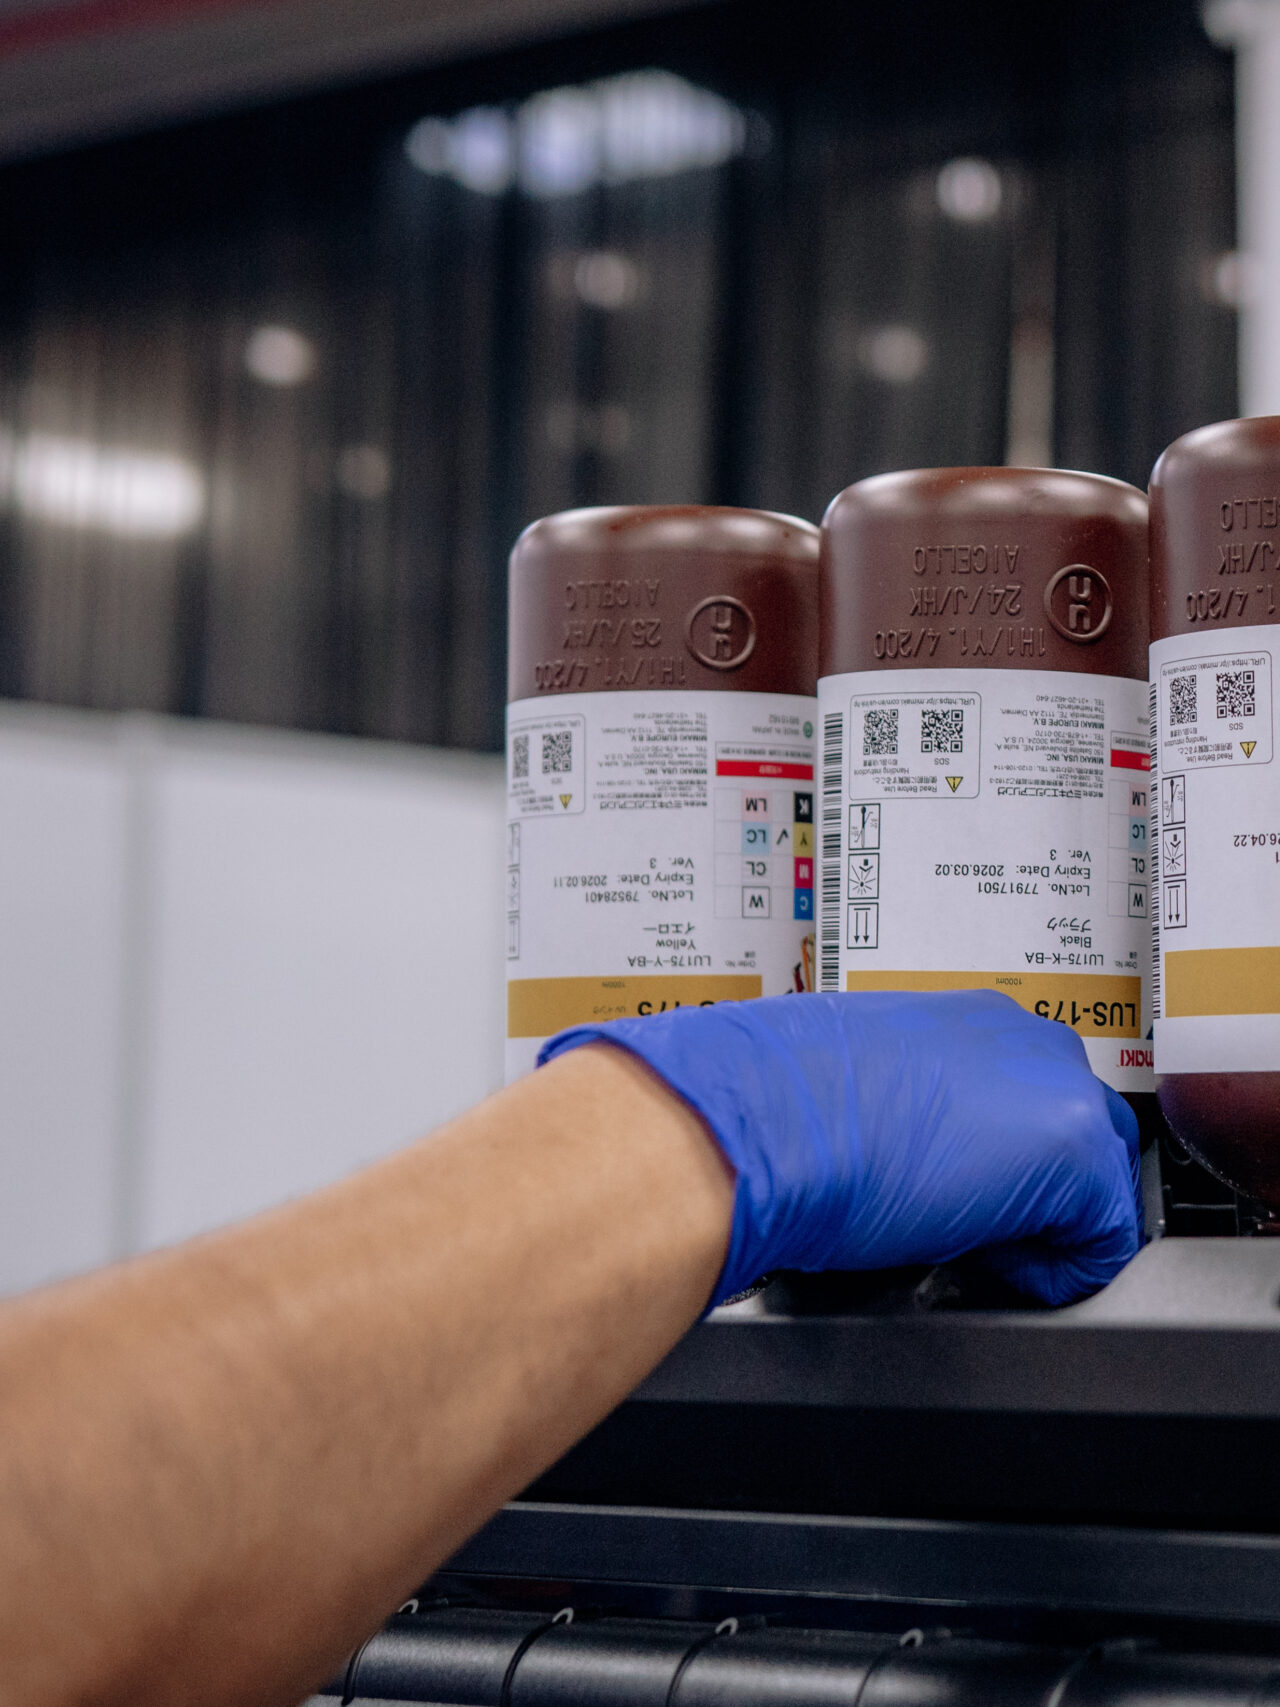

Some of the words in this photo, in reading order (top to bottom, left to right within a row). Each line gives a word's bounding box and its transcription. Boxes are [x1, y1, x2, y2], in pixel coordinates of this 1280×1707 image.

[912, 545, 1020, 575] AICELLO
[1049, 719, 1079, 727] EUROPE
[1081, 721, 1104, 729] MIMAKI
[1229, 722, 1244, 730] SDS
[1186, 736, 1208, 744] Handling
[1062, 754, 1078, 762] USA,
[1080, 756, 1104, 764] MIMAKI
[883, 767, 909, 775] Handling
[1132, 791, 1146, 806] LM
[746, 798, 767, 812] LM
[799, 799, 809, 815] K
[746, 830, 766, 844] LC
[1132, 824, 1145, 838] LC
[800, 832, 807, 846] Y
[1050, 849, 1056, 861] 3
[1068, 850, 1091, 862] Ver.
[649, 858, 656, 868] 3
[669, 857, 694, 868] Ver.
[1132, 858, 1145, 873] CL
[746, 862, 766, 876] CL
[935, 864, 1004, 876] 2026.03.02
[1016, 865, 1049, 877] Date:
[1055, 865, 1090, 879] Expiry
[553, 875, 607, 887] 2026.02.11
[617, 874, 650, 885] Date:
[655, 872, 693, 884] Expiry
[977, 882, 1038, 894] 77917501
[585, 890, 639, 902] 79528401
[749, 894, 764, 908] W
[1133, 893, 1143, 907] W
[800, 896, 808, 910] C
[643, 922, 695, 934] イエロー
[1047, 918, 1091, 931] ブラック
[656, 939, 696, 950] Yellow
[1060, 936, 1091, 948] Black
[627, 956, 711, 967] LU175-Y-BA
[1025, 952, 1103, 965] LU175-K-BA
[995, 977, 1022, 986] 1000ml
[1034, 1000, 1136, 1027] LUS-175
